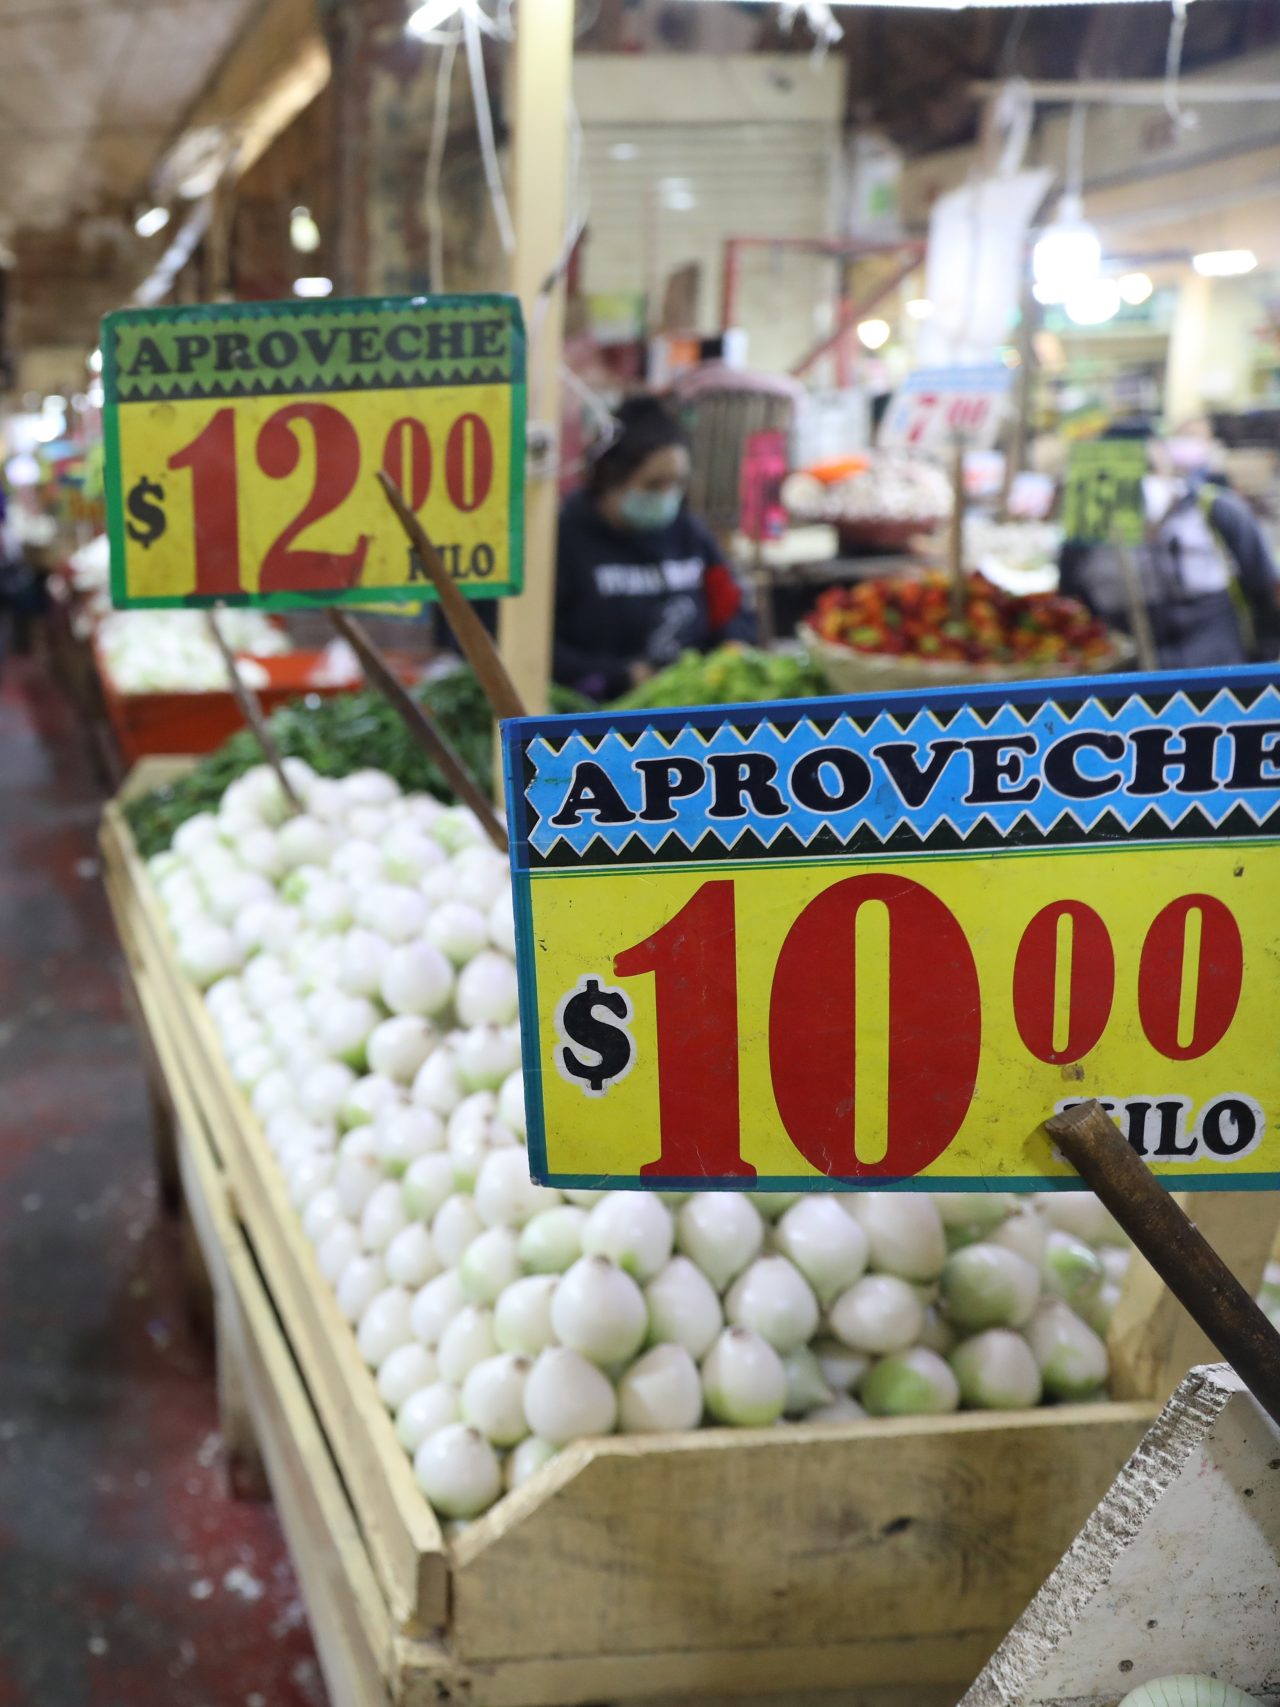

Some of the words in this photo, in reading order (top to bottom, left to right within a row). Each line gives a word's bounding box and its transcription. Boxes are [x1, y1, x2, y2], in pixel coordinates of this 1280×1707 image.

[127, 320, 506, 376] APROVECHE
[127, 476, 166, 549] $
[551, 723, 1280, 827] APROVECHE
[561, 978, 632, 1092] $
[1063, 1098, 1257, 1157] ILO
